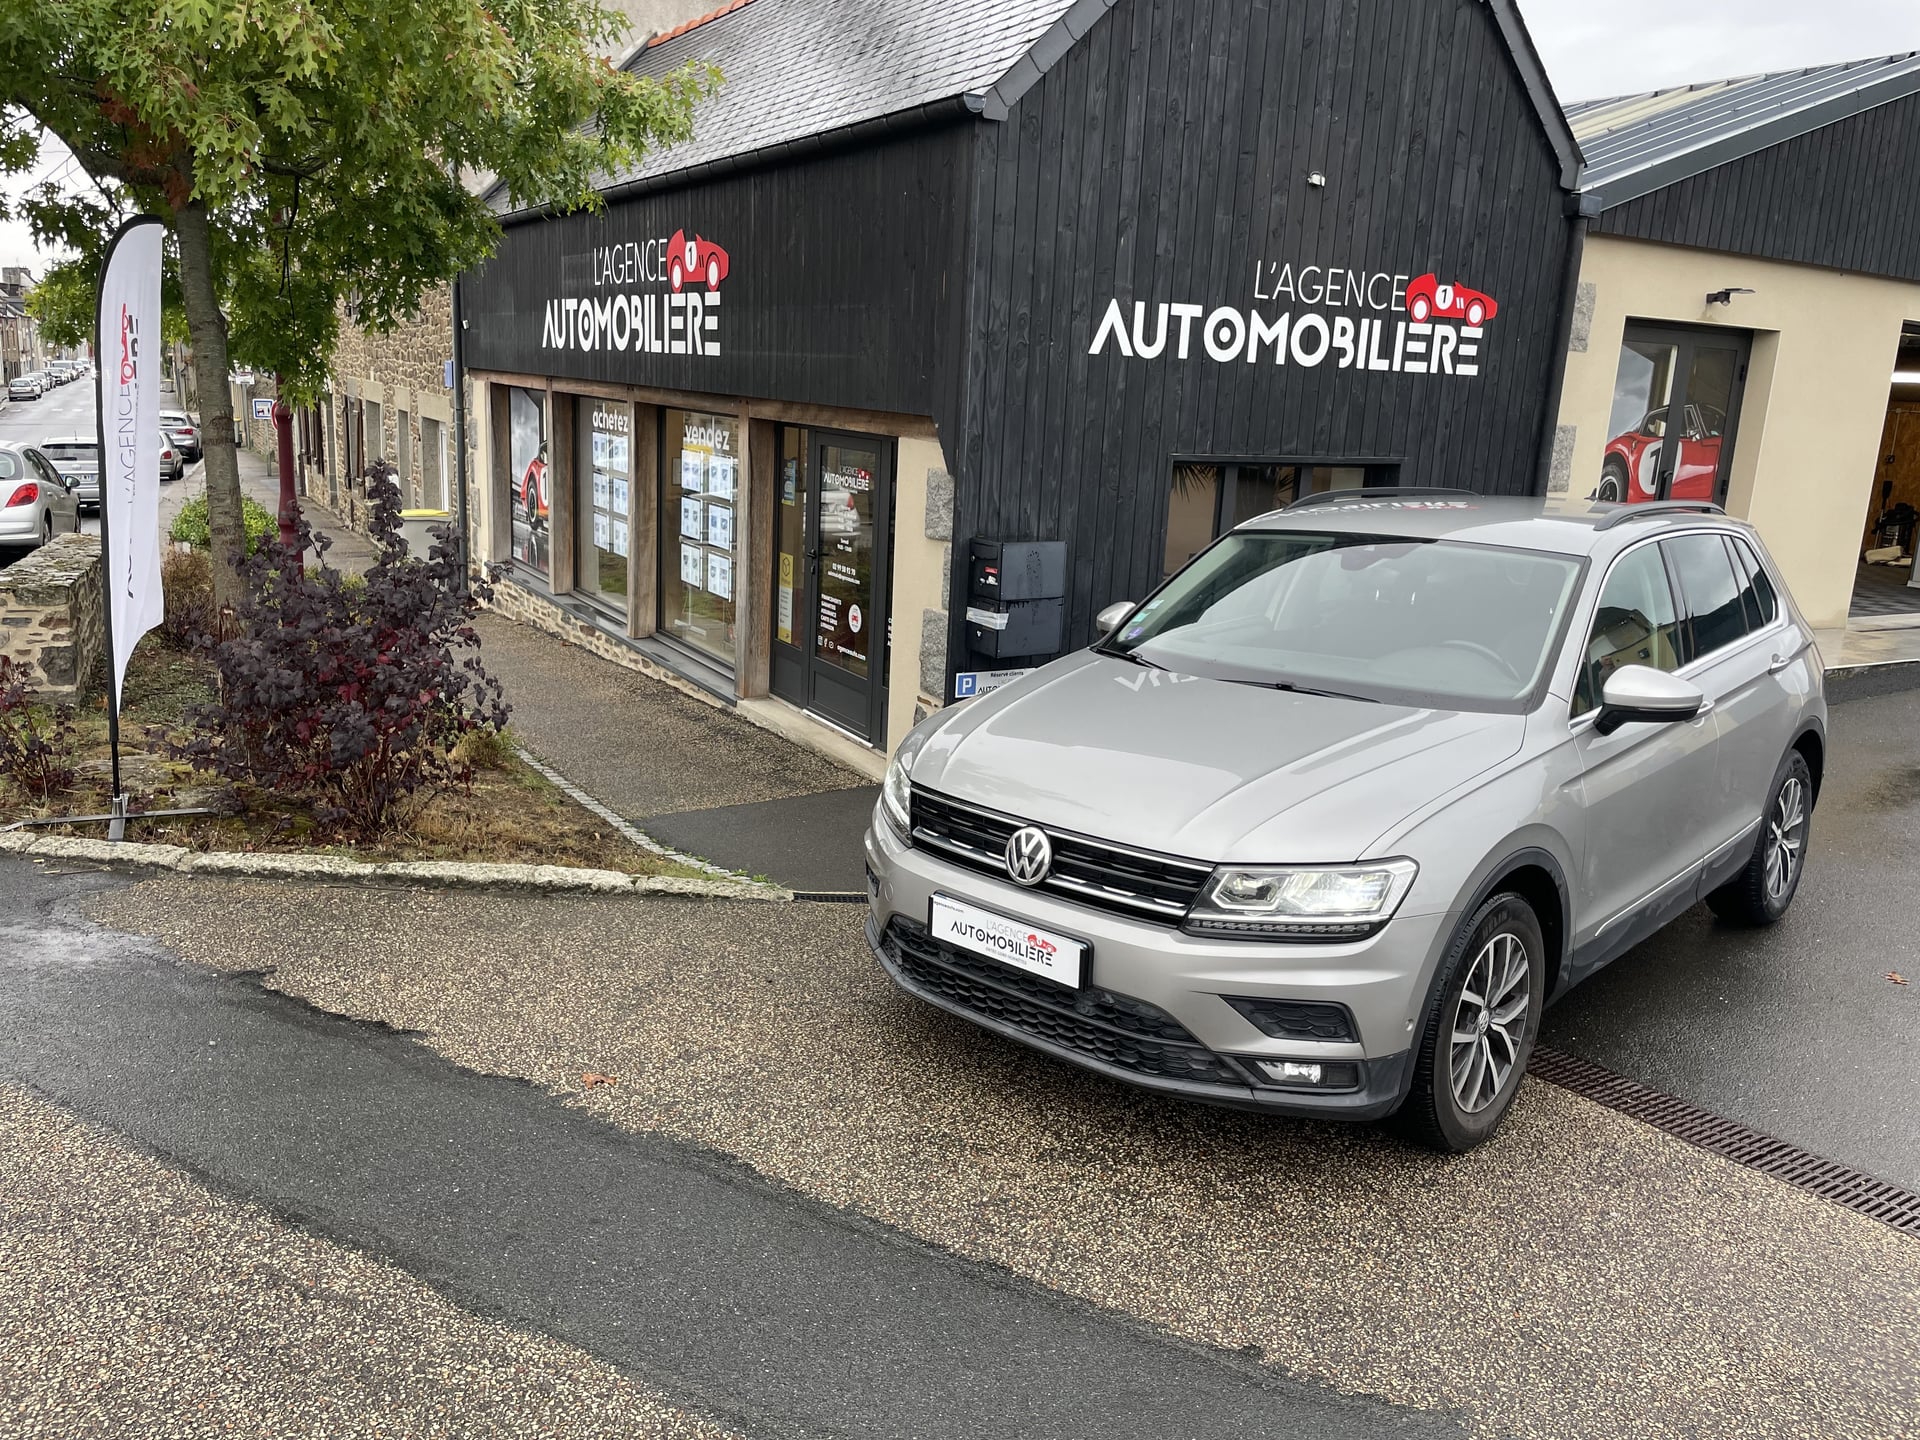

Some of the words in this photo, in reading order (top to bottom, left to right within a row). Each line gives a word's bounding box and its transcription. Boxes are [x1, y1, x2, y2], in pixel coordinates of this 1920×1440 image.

[593, 238, 668, 286] L'AGENCE
[1253, 259, 1409, 312] L'AGENCE
[592, 402, 628, 432] achetez
[684, 415, 730, 451] vendez
[962, 678, 972, 694] P
[986, 920, 1028, 943] L'AGENCE
